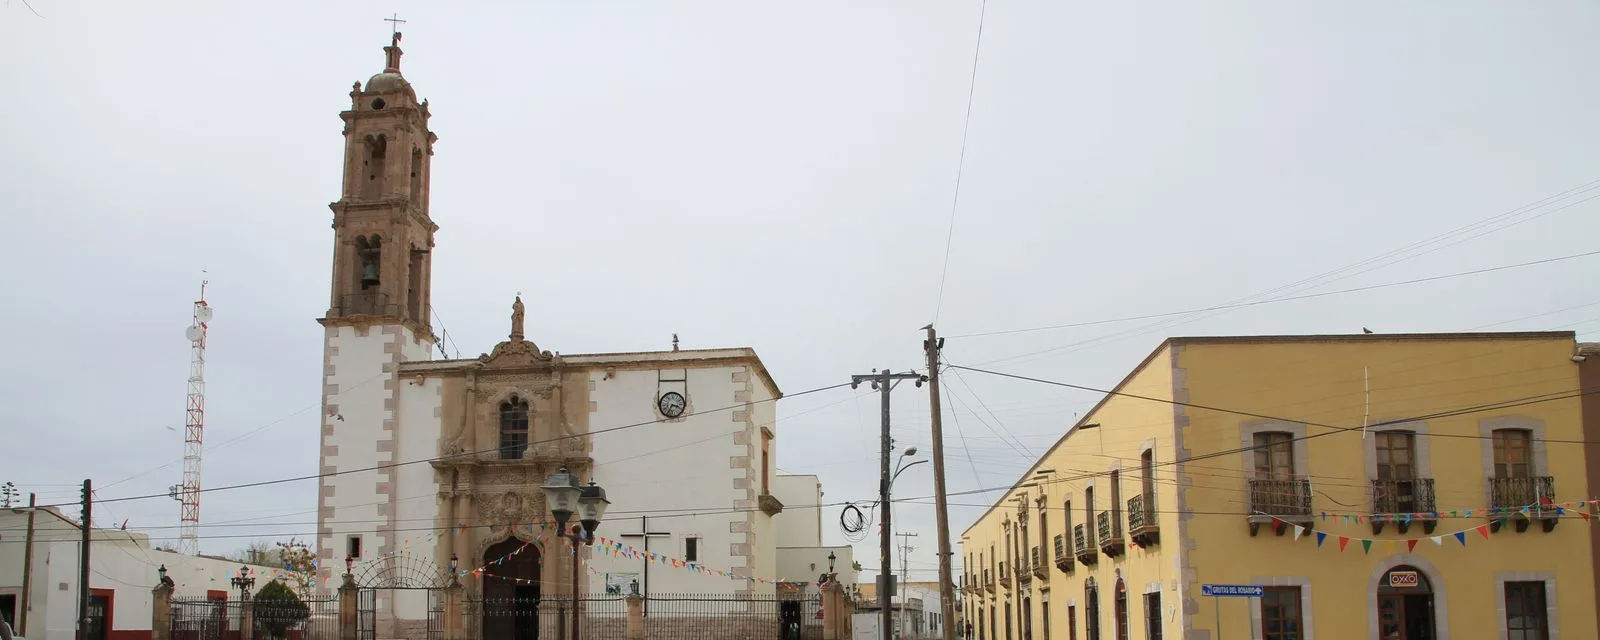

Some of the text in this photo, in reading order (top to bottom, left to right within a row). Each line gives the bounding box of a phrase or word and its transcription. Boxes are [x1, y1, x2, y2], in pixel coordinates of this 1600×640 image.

[1392, 574, 1416, 584] OXXO
[1212, 586, 1255, 594] GRUTAS DEL ROSARIO
